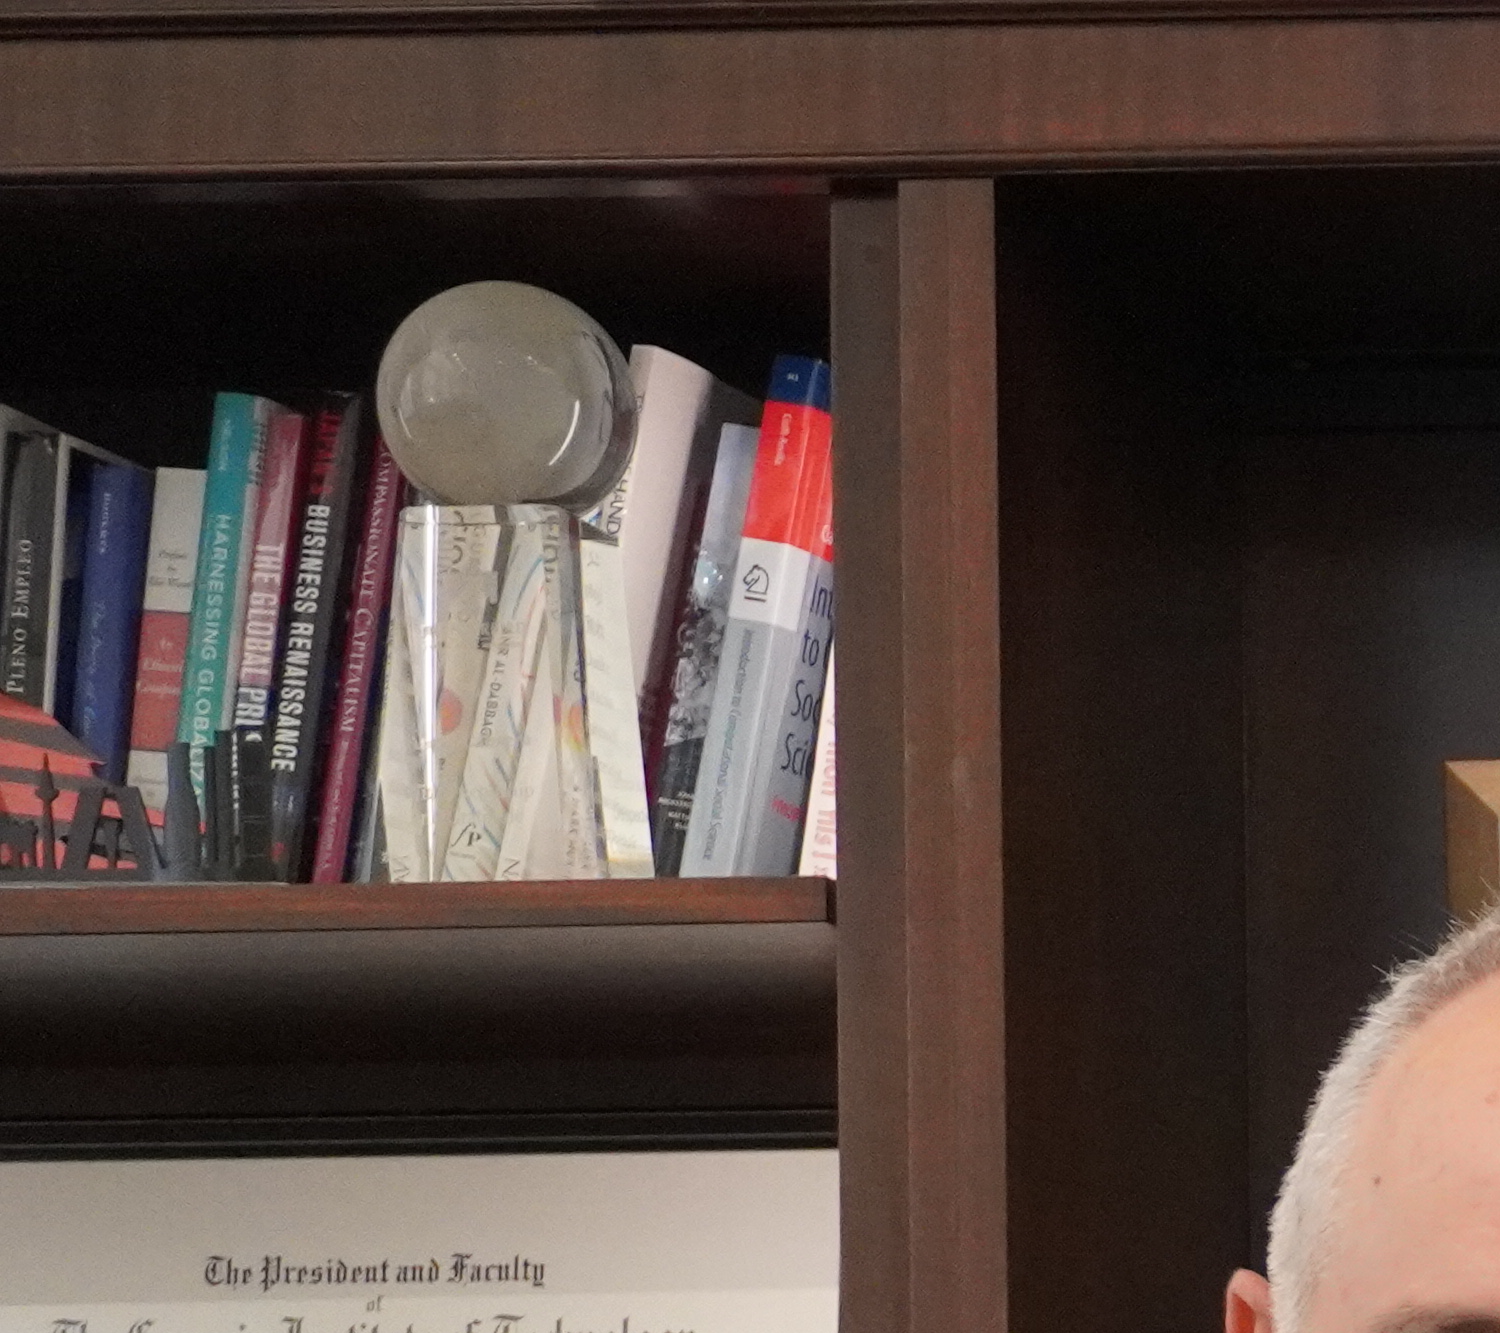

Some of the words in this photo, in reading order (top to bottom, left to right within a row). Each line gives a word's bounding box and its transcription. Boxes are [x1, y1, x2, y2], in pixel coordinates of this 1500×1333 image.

[12, 537, 34, 621] EMPLEO
[198, 514, 231, 662] HARNESSING
[253, 541, 286, 586] THE
[294, 503, 331, 614] BUSINESS
[5, 626, 29, 695] PLENO
[239, 590, 281, 689] GLOBAL
[341, 607, 377, 734] CAPITALISM
[270, 619, 315, 774] RENAISSANCE
[204, 1255, 253, 1290] The
[261, 1254, 390, 1292] President
[396, 1257, 440, 1285] and
[446, 1252, 546, 1289] Faculty
[365, 1294, 385, 1314] of
